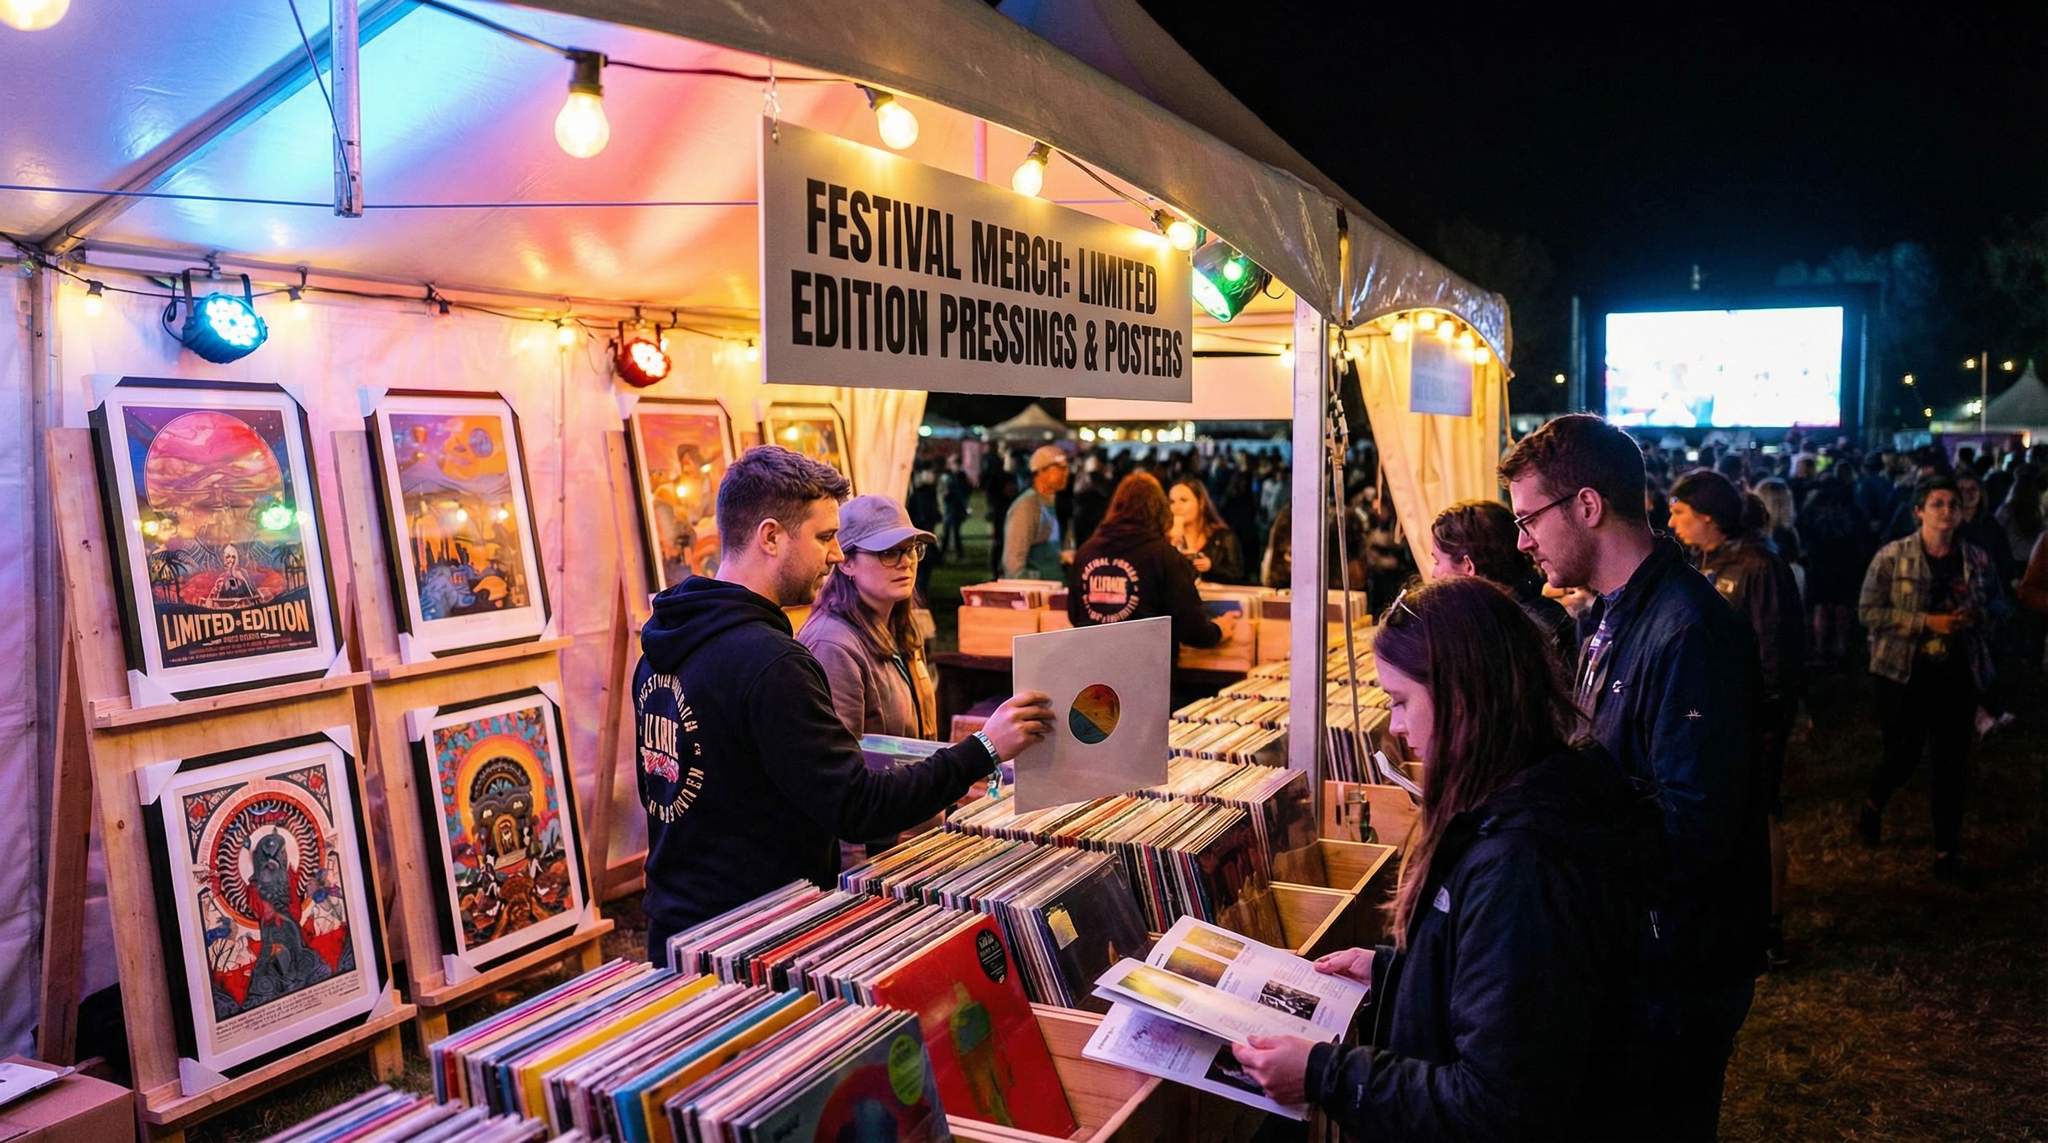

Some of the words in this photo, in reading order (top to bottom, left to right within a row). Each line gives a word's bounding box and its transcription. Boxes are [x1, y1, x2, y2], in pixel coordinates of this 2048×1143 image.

[806, 178, 962, 281] FESTIVAL
[971, 220, 1071, 299] MERCH:
[1079, 247, 1157, 315] LIMITED
[791, 269, 928, 357] EDITION
[940, 293, 1077, 370] PRESSINGS
[1084, 320, 1098, 371] &
[1105, 320, 1183, 378] POSTERS
